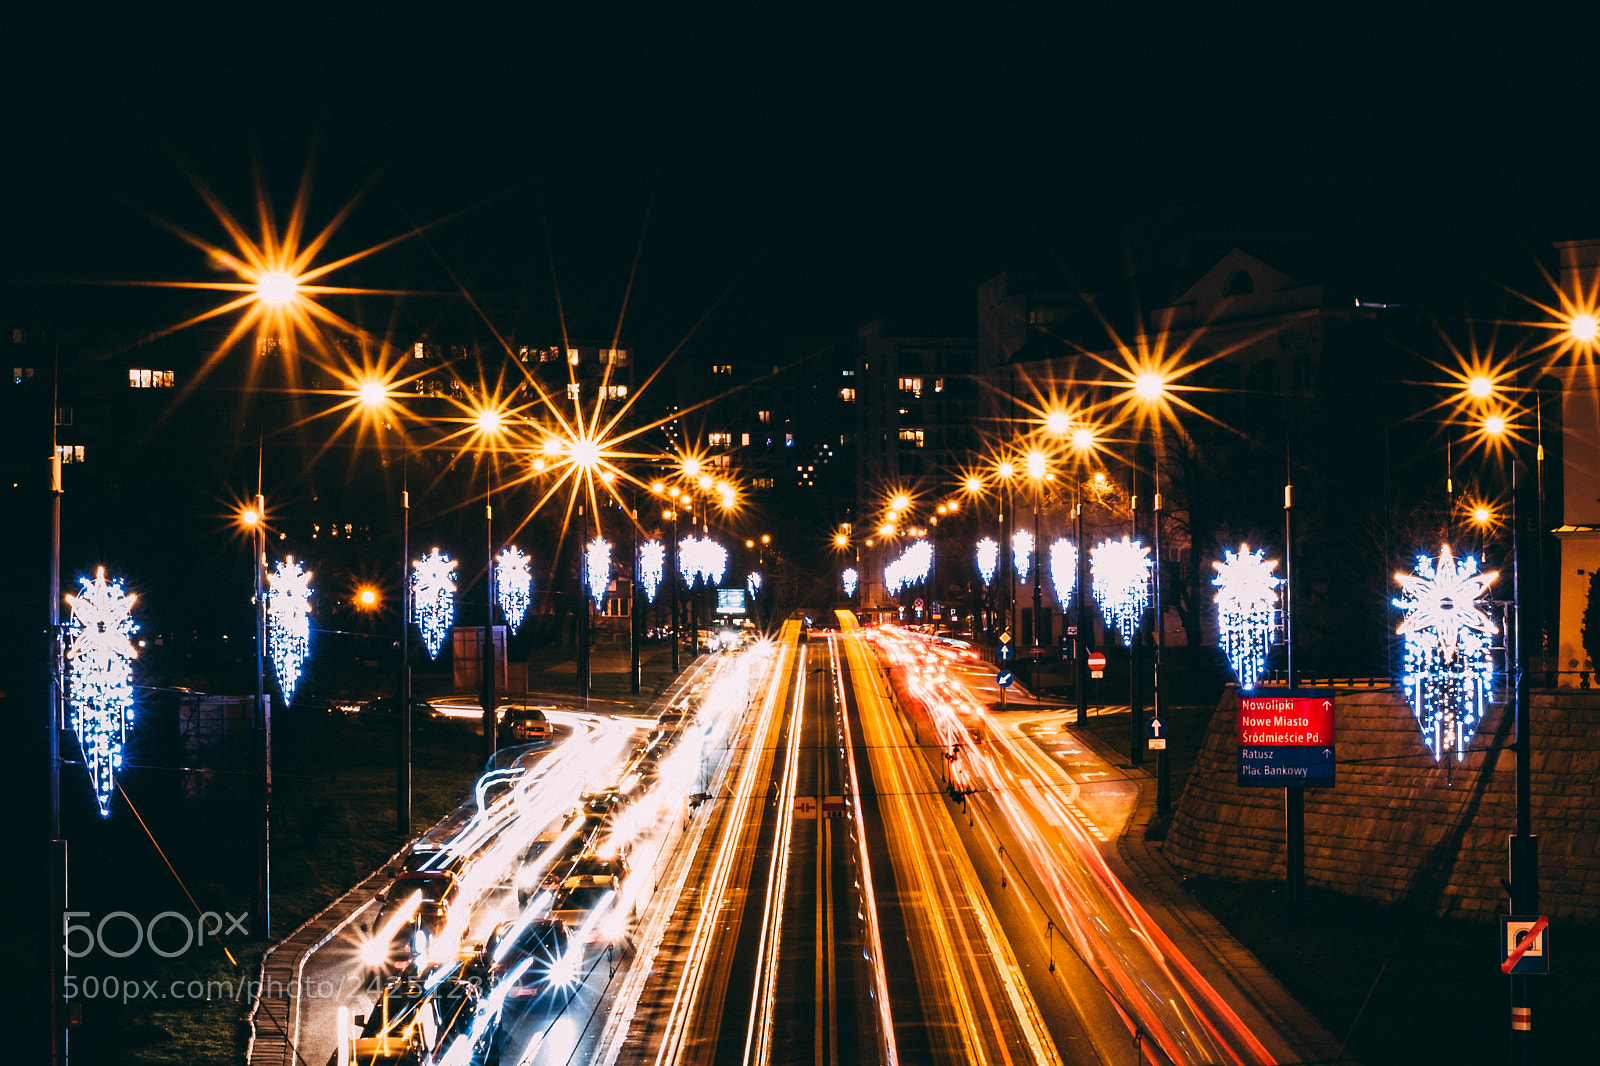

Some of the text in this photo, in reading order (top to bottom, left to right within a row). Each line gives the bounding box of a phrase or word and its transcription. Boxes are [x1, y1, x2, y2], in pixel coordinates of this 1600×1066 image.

[1242, 700, 1294, 713] Nowolipki
[1242, 716, 1309, 727] Nowe Miasto
[1242, 730, 1323, 743] Śródmieście Pd.
[1242, 749, 1274, 759] Ratusz
[1242, 765, 1308, 778] Plac Bankowy
